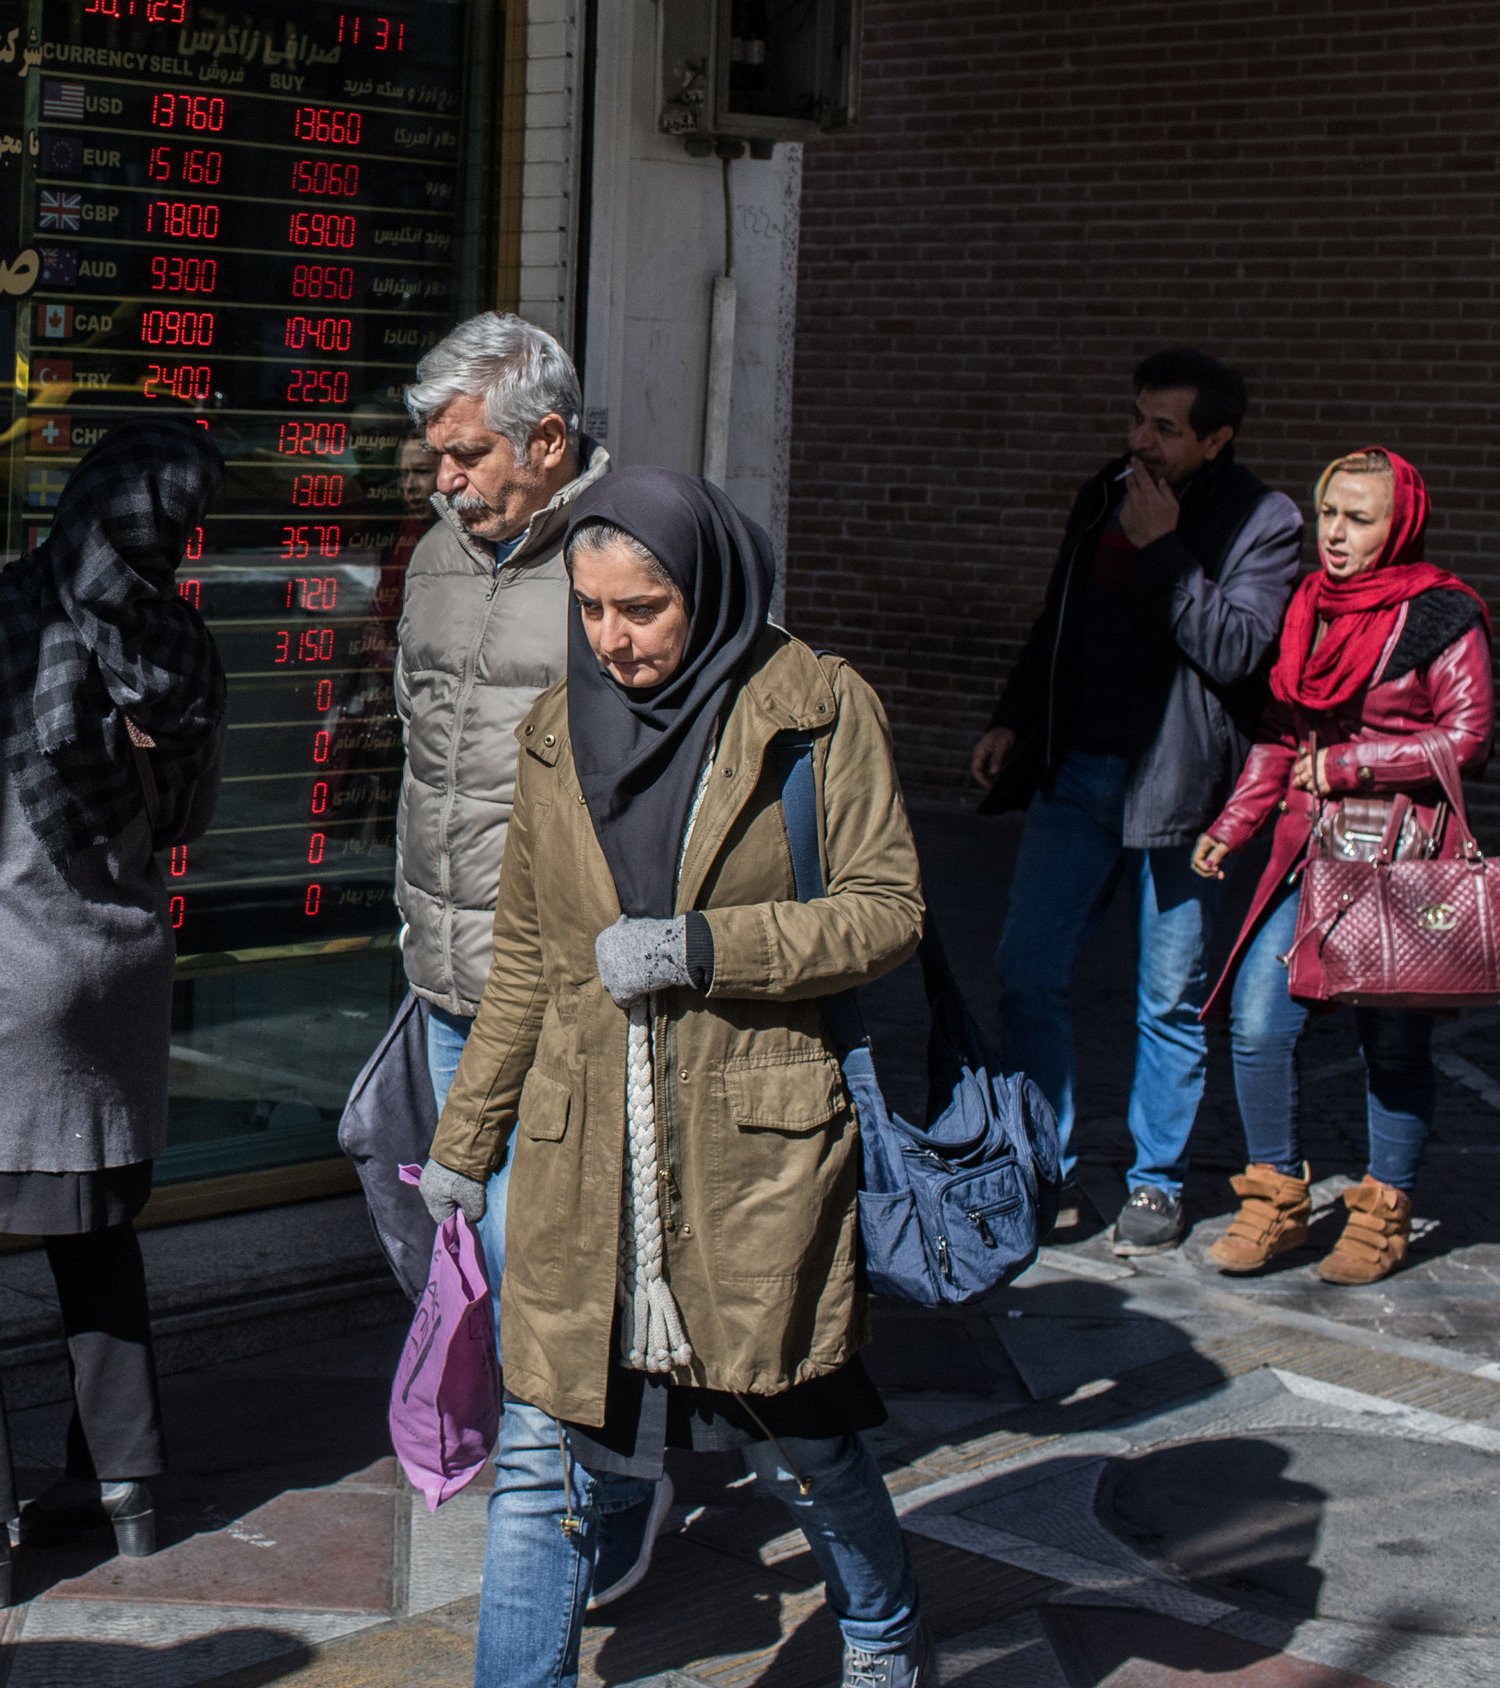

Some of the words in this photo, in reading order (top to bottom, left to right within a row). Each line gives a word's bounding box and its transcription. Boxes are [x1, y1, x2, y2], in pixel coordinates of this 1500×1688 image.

[43, 42, 148, 71] CURRENCY
[150, 55, 193, 77] SELL
[198, 61, 245, 84] فروش
[270, 73, 305, 91] BUY
[343, 77, 374, 97] خرید
[85, 95, 124, 115] USD
[151, 93, 225, 132] 13760
[294, 108, 362, 145] 13660
[28, 130, 40, 170] با
[83, 148, 122, 168] EUR
[148, 146, 222, 185] 15160
[292, 160, 359, 196] 15060
[81, 203, 120, 223] GBP
[147, 201, 220, 239] 17800
[288, 212, 356, 248] 16900
[78, 259, 118, 279] AUD
[151, 256, 217, 293] 9300
[292, 265, 355, 300] 8850
[74, 314, 113, 332] CAD
[141, 310, 214, 346] 10900
[284, 316, 352, 351] 10400
[75, 372, 112, 390] TRY
[144, 364, 211, 400] 2400
[286, 369, 349, 404] 2250
[278, 422, 346, 455] 13200
[292, 474, 344, 507] 1300
[280, 525, 341, 559] 3570
[286, 577, 337, 610] 1720
[317, 679, 333, 712] 0
[313, 730, 331, 763] 0
[311, 781, 328, 814] 0
[307, 832, 325, 865] 0
[304, 884, 322, 916] 0
